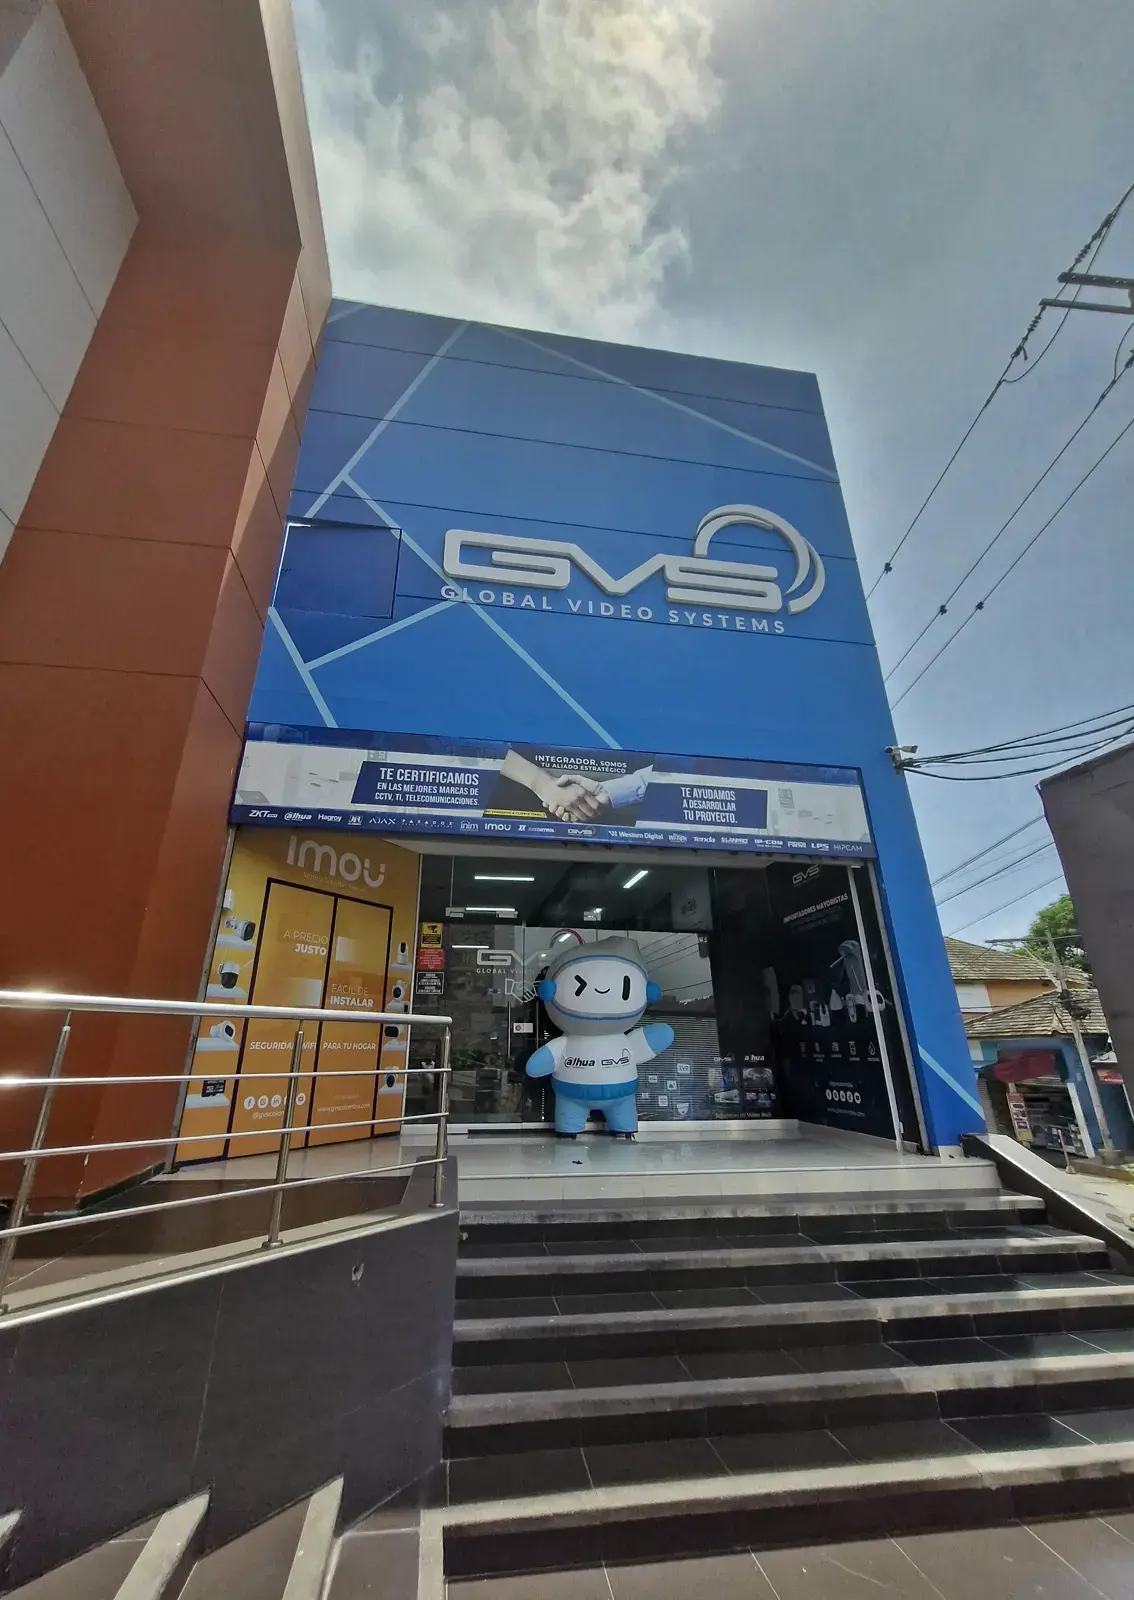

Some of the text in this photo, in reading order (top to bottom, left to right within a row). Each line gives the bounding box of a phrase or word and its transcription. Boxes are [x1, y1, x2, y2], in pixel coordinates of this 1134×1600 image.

[443, 529, 783, 613] GVS
[440, 585, 785, 634] GLOBAL VIDEO SYSTEMS
[535, 754, 627, 768] INTEGRADOR, SOMOS
[380, 767, 480, 786] TE CERTIFICAMOS
[377, 782, 479, 796] EN LAS MEJORES MARCAS DE
[681, 787, 736, 801] TE AYUDAMOS
[375, 792, 480, 806] CCTV, TI, TELECOMUNICACIONES.
[683, 799, 736, 811] A DESARROLLAR
[683, 809, 738, 823] TU PROYECTO.
[318, 814, 343, 822] Hagroy
[619, 831, 644, 839] Western
[644, 832, 664, 841] Digital
[833, 844, 863, 852] HIPCAM
[792, 863, 820, 884] GVS
[816, 892, 848, 911] MAYORISTAS
[283, 929, 329, 945] A PRECIO
[295, 943, 327, 956] JUSTO
[357, 986, 369, 996] DE
[330, 995, 374, 1008] INSTALAR
[250, 1041, 294, 1050] SEGURIDA
[323, 1042, 342, 1050] PARA
[343, 1042, 352, 1050] TU
[352, 1042, 376, 1050] HOGAR
[601, 1056, 630, 1066] GVS
